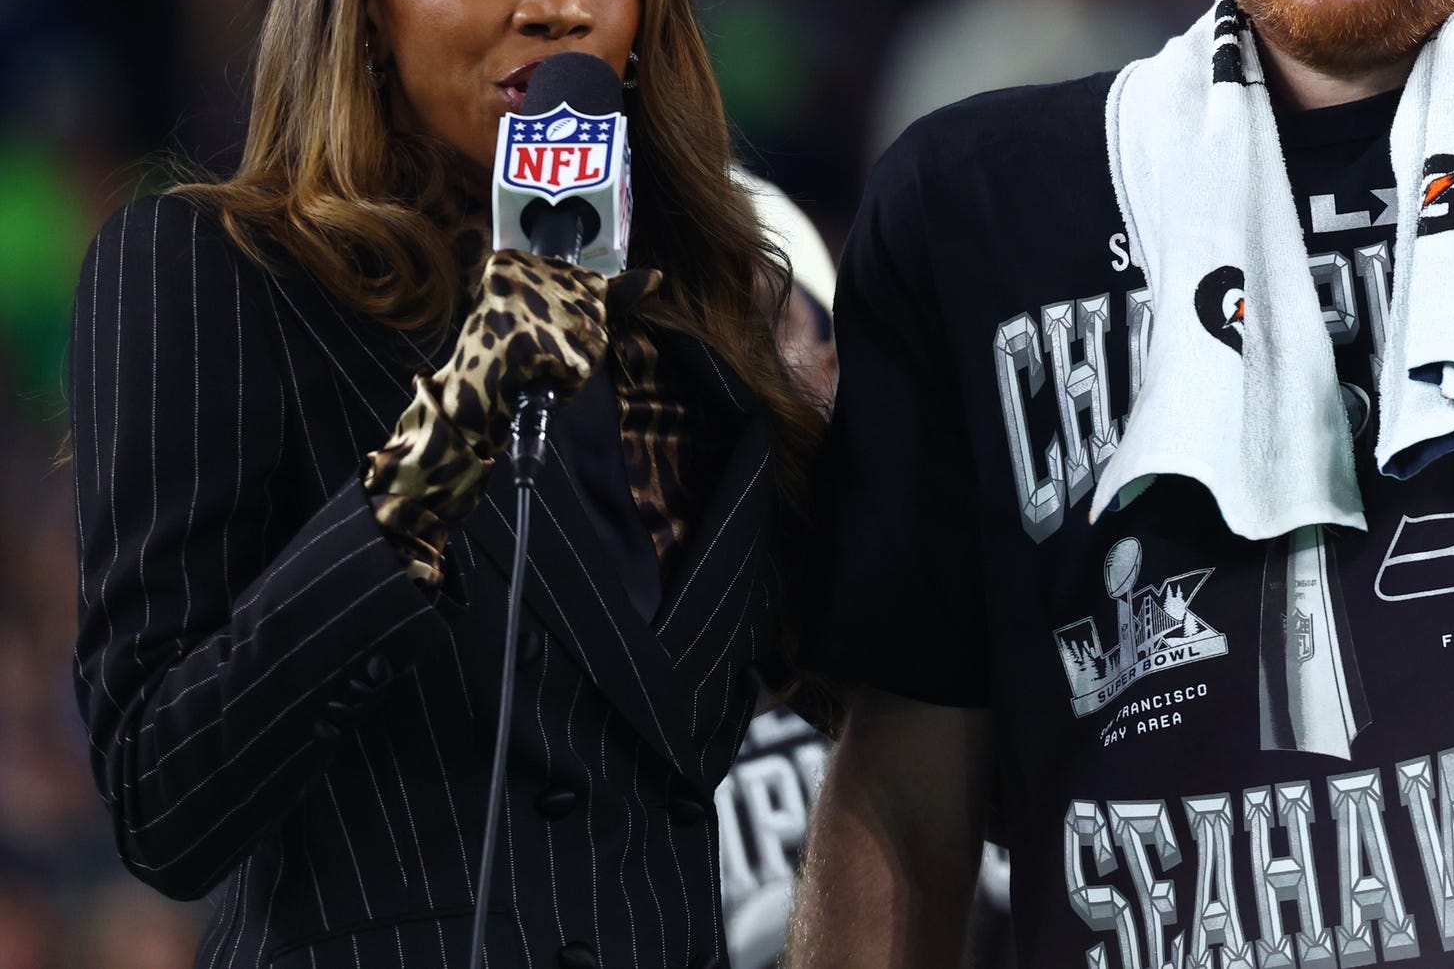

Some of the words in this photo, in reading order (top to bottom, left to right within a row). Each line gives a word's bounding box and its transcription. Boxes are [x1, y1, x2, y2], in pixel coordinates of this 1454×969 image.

[513, 147, 600, 187] NFL
[1097, 669, 1136, 704] SUPER
[1142, 645, 1201, 671] BOWL
[1115, 683, 1208, 722] FRANCISCO
[1103, 726, 1127, 747] BAY
[1136, 712, 1183, 735] AREA
